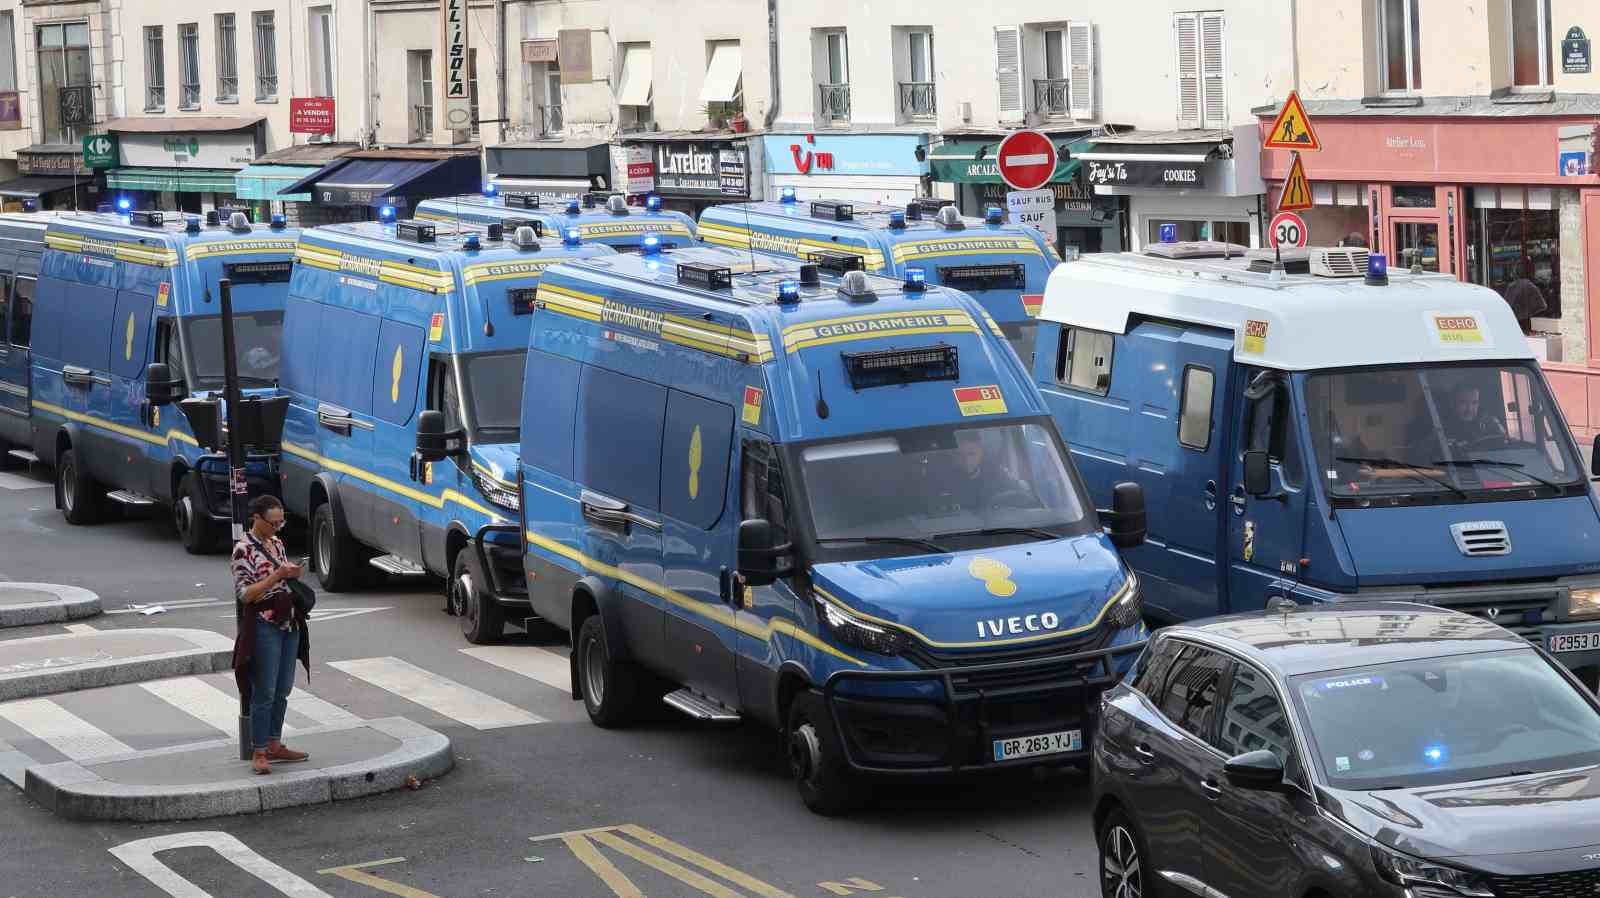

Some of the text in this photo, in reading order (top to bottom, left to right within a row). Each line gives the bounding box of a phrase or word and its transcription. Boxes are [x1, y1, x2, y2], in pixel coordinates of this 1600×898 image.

[1164, 169, 1196, 182] COOKIES
[1010, 197, 1031, 206] SAUF
[1035, 195, 1051, 204] BUS
[1020, 213, 1045, 223] SAUF
[590, 224, 672, 233] GENDARMERIE
[1277, 225, 1299, 244] 30
[919, 240, 1017, 253] GENDARMERIE
[602, 301, 664, 335] GENDARMERIE
[818, 315, 944, 337] GENDARMERIE
[981, 388, 1000, 400] B1
[976, 611, 1059, 638] IVECO
[1560, 635, 1588, 650] 2953
[1326, 677, 1372, 689] POLICE
